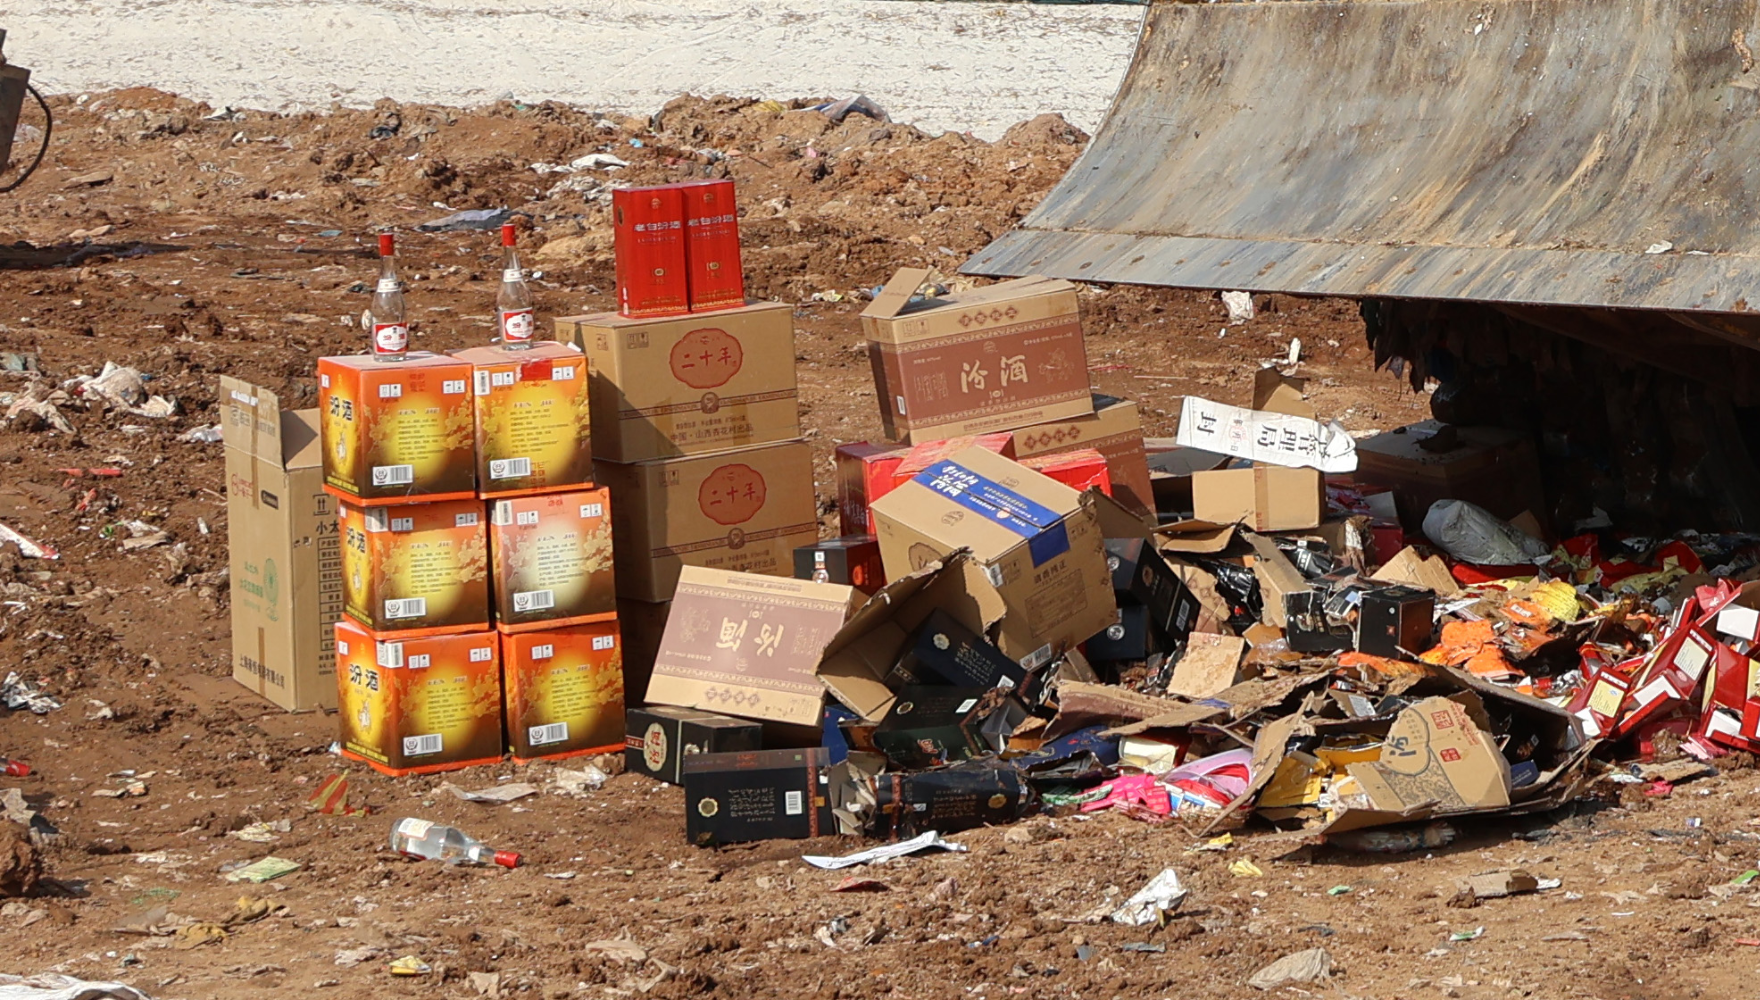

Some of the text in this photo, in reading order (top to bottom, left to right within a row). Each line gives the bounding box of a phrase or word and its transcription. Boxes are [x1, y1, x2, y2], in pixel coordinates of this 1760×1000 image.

[633, 220, 682, 232] 老白汾酒
[681, 346, 734, 369] 二十年
[960, 354, 1029, 394] 汾酒
[330, 395, 354, 422] 汾酒
[1196, 411, 1218, 437] 封
[709, 482, 756, 506] 二十年
[346, 526, 367, 554] 汾酒
[715, 616, 785, 658] 汾酒
[349, 663, 380, 692] 汾酒
